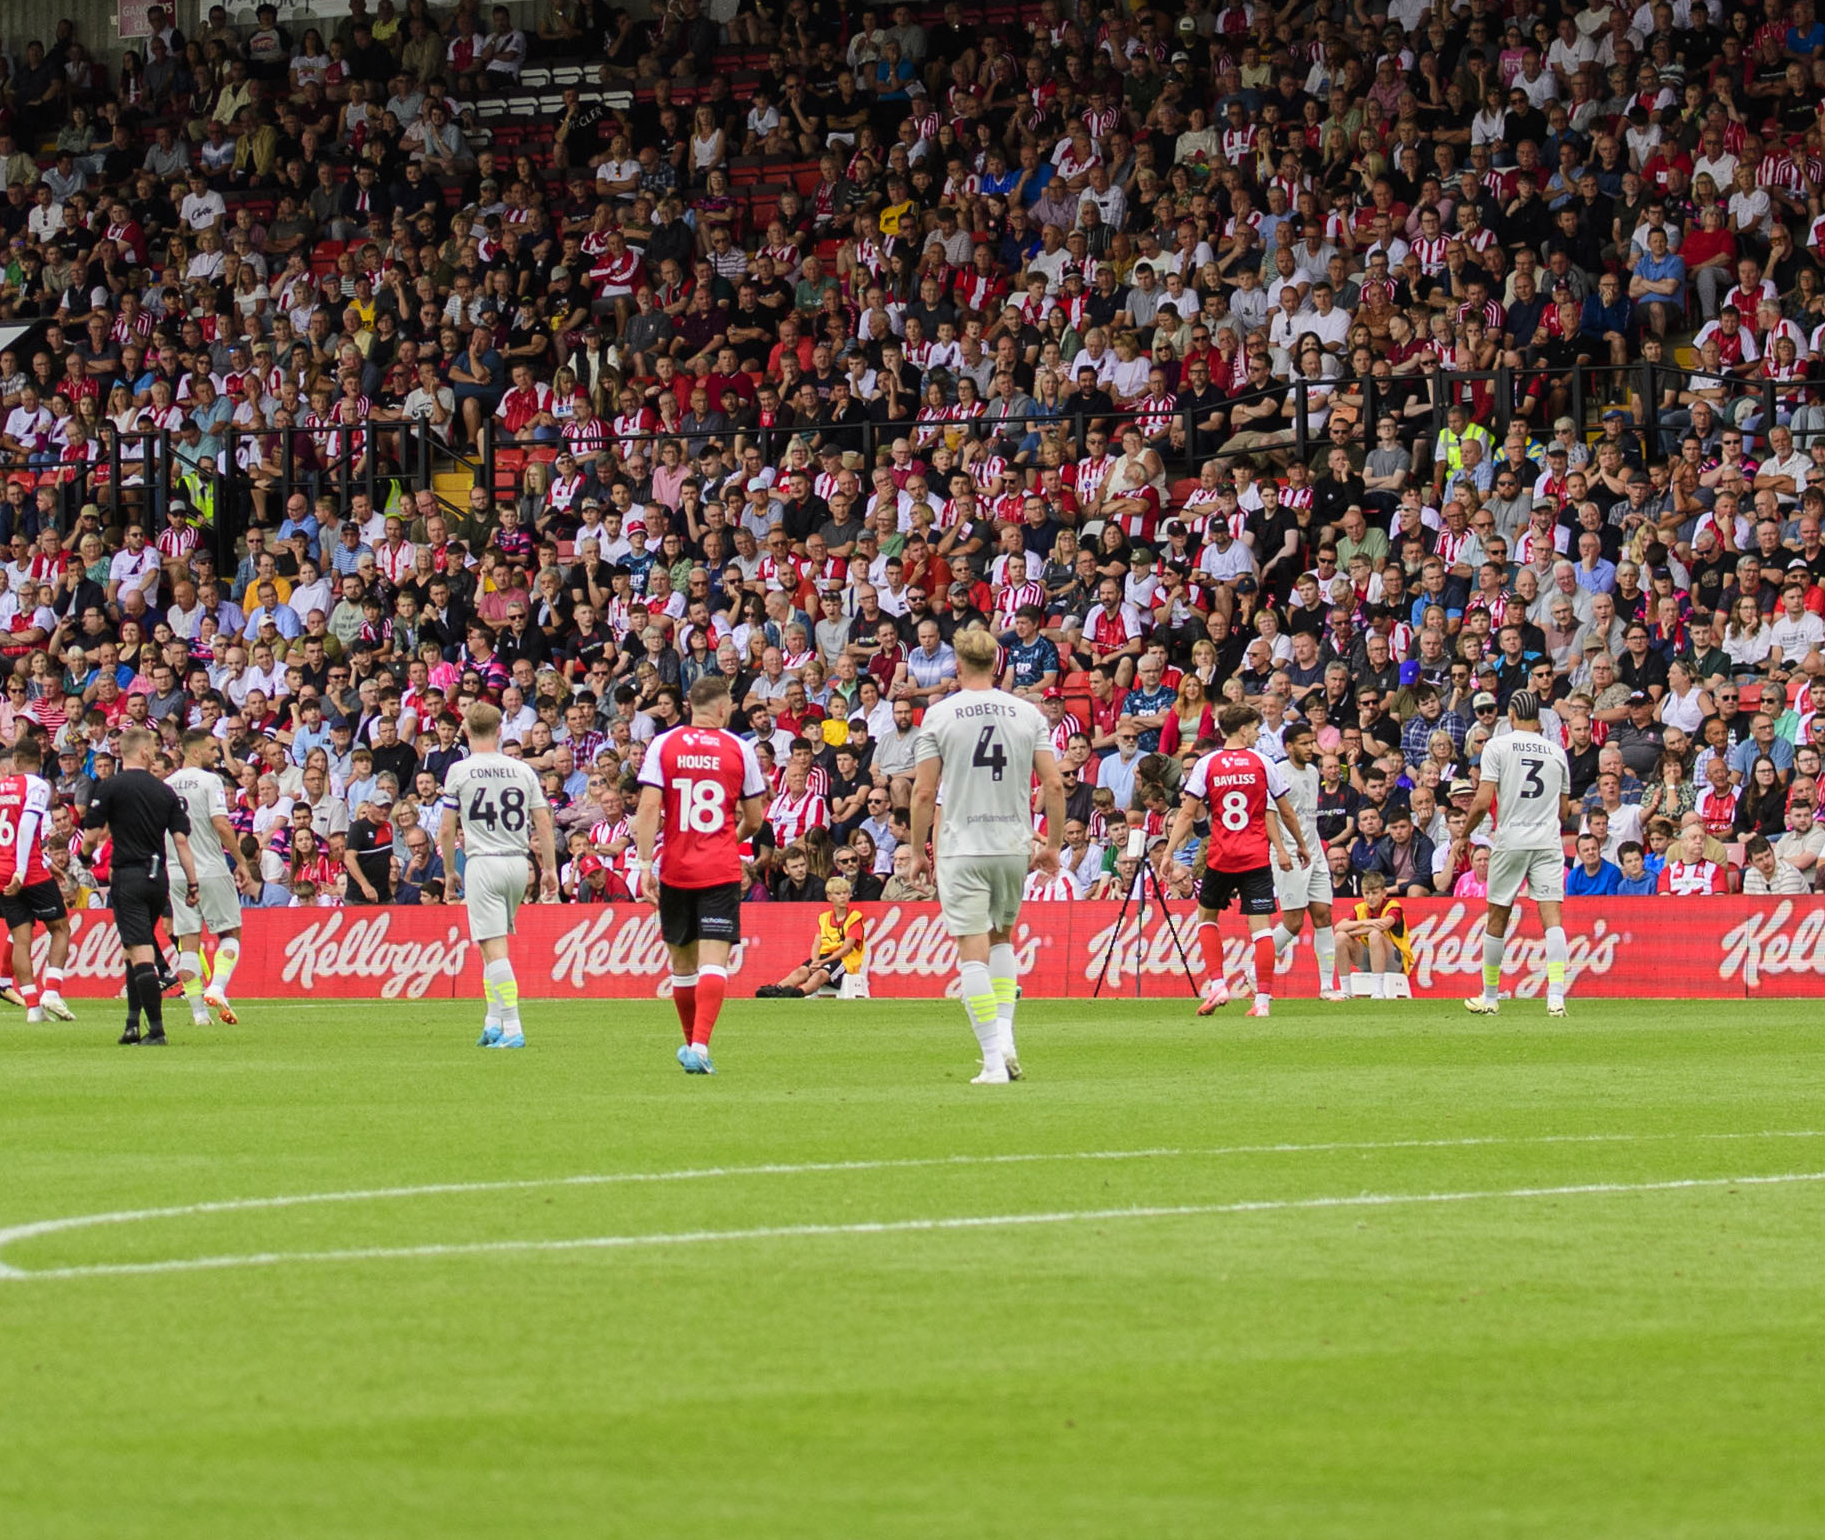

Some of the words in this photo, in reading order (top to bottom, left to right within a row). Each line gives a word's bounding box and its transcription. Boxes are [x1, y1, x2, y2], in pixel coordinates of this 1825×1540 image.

[955, 702, 1017, 720] ROBERTS
[677, 754, 720, 771] HOUSE
[972, 724, 1007, 781] 4
[1512, 742, 1553, 756] RUSSELL
[470, 767, 518, 779] CONNELL
[1213, 773, 1256, 788] BAYLISS
[1520, 758, 1545, 799] 3
[469, 786, 525, 832] 48
[671, 777, 726, 833] 18
[1221, 790, 1250, 831] 8
[282, 910, 470, 998] Kellogg's
[551, 907, 749, 998] Kellos
[857, 905, 1042, 998] Kello's
[1085, 905, 1300, 998] Kellgs
